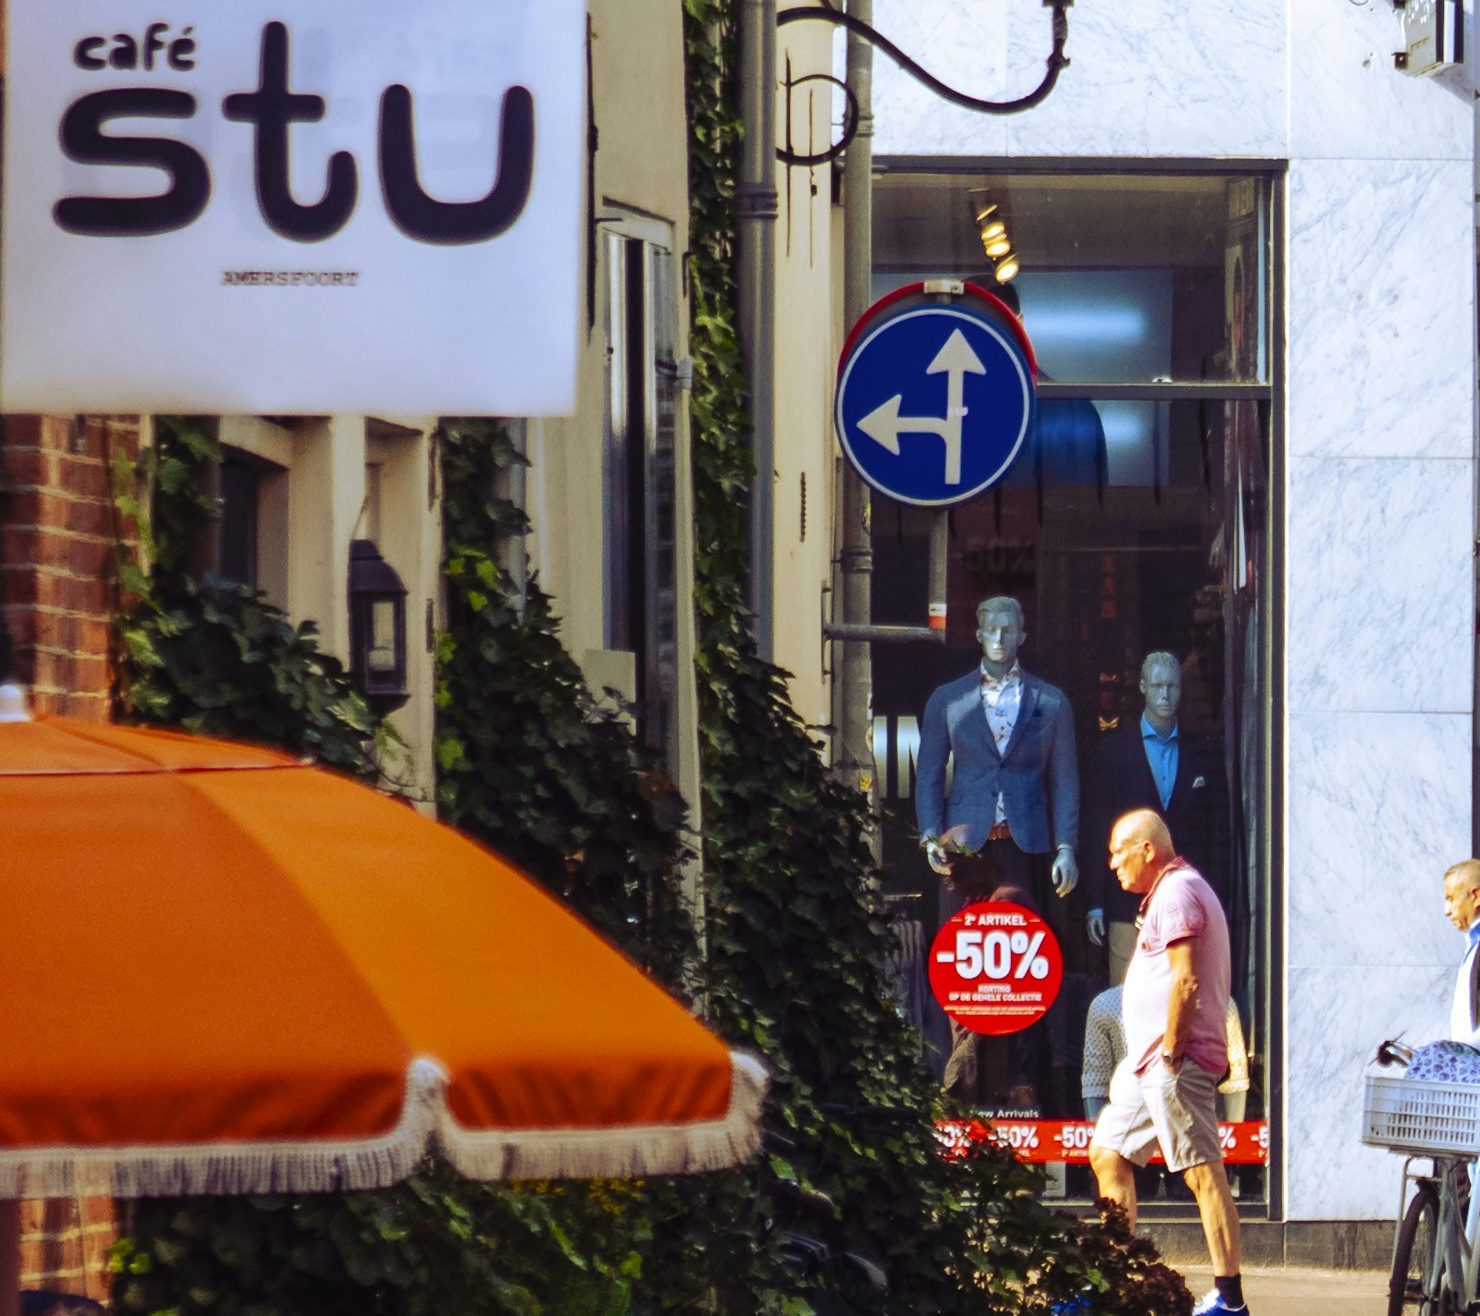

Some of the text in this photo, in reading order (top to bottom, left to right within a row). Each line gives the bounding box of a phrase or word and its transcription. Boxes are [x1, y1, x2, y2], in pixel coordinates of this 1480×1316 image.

[74, 22, 196, 71] café
[222, 270, 361, 286] AMERSFOORT
[978, 913, 1028, 926] ARTIKEL
[936, 930, 1049, 980] -50%
[997, 1109, 1039, 1118] Arrivals
